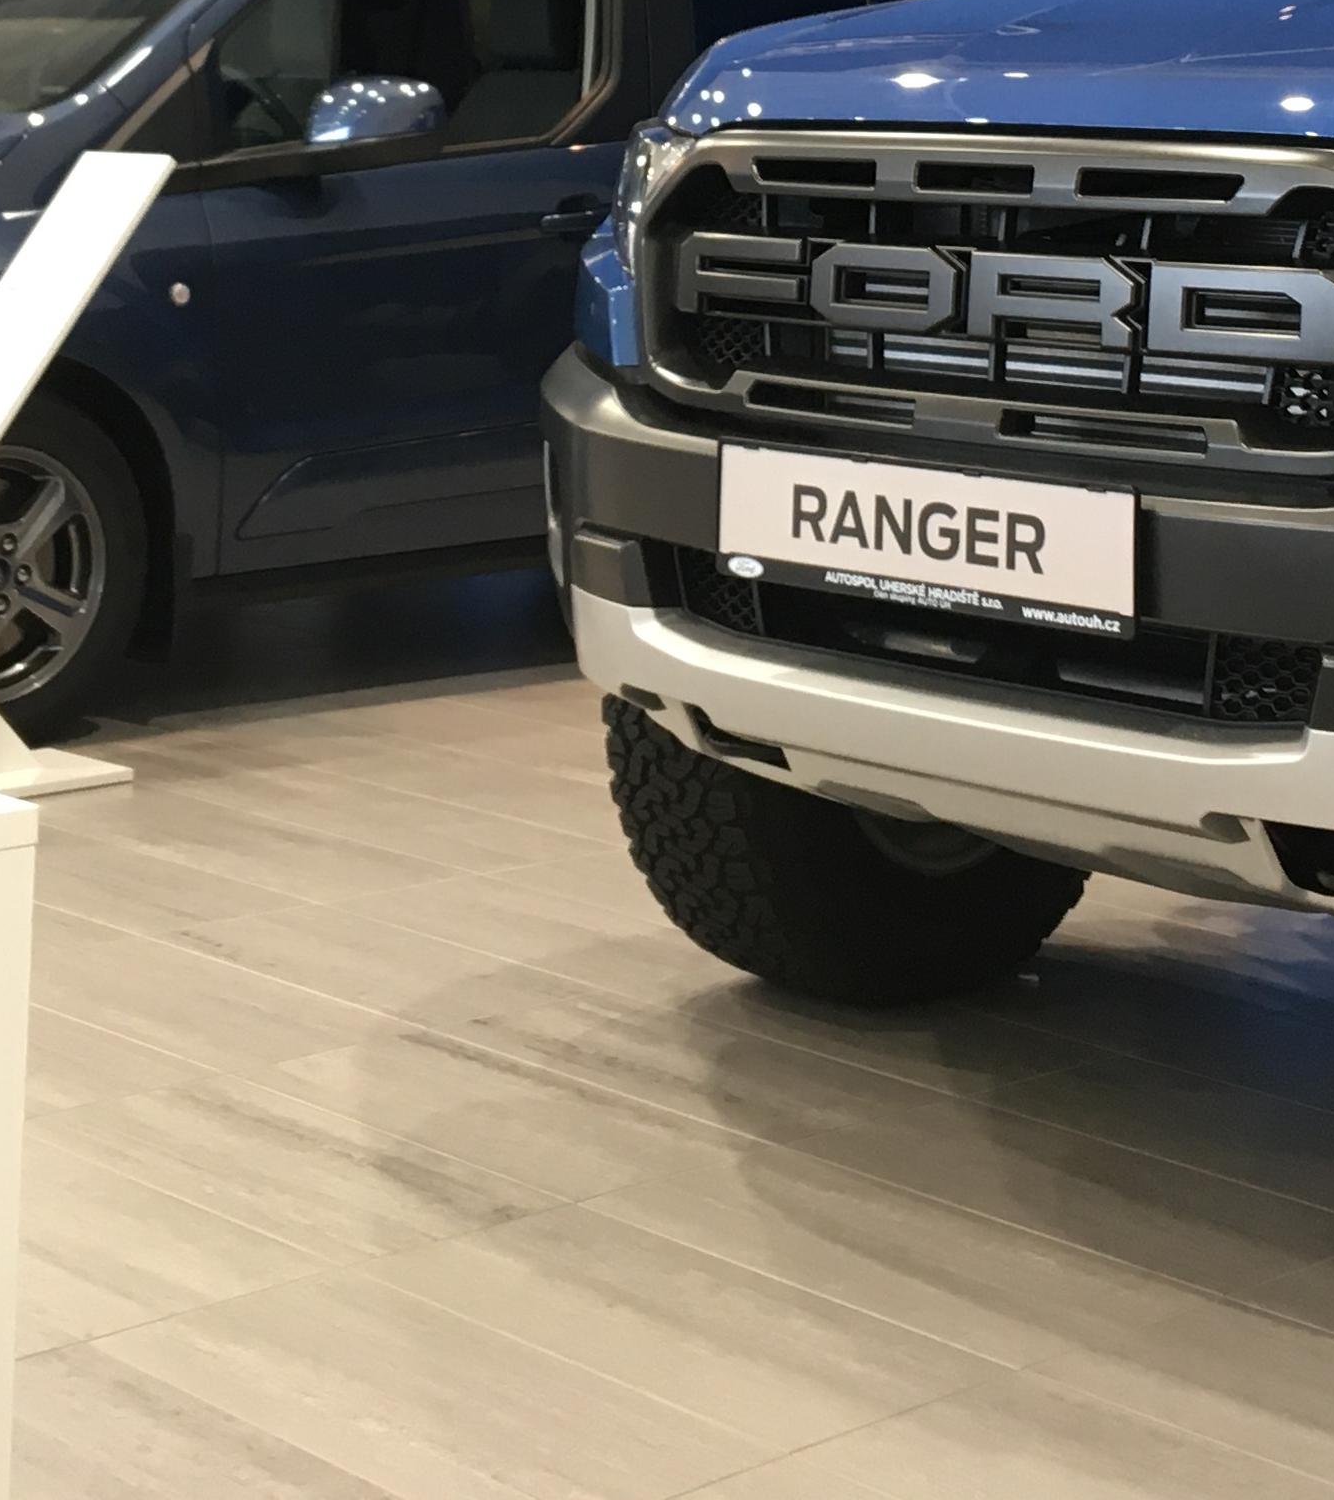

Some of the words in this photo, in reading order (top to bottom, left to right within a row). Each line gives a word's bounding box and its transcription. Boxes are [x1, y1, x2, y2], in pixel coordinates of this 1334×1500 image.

[791, 483, 1046, 575] RANGER
[824, 570, 878, 590] AUTOSPOL
[879, 579, 926, 598] UHERSKÉ
[1021, 606, 1121, 633] www.autouh.cz
